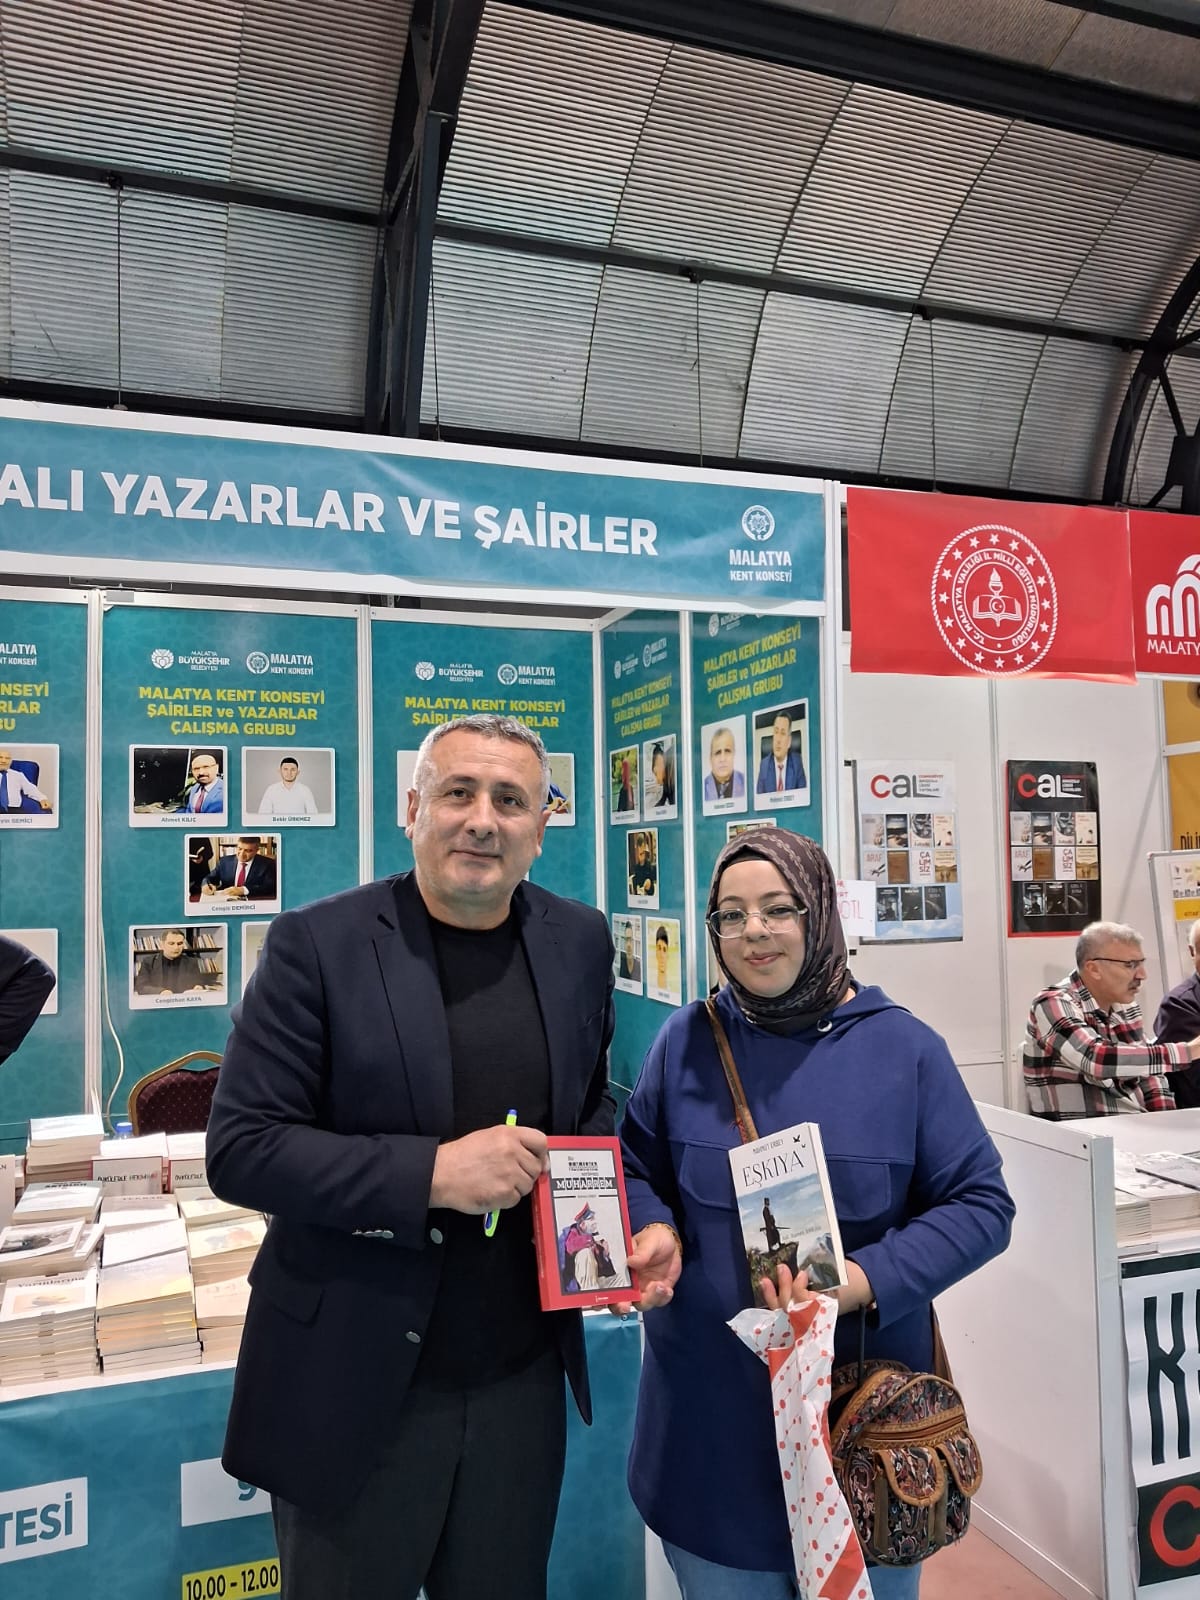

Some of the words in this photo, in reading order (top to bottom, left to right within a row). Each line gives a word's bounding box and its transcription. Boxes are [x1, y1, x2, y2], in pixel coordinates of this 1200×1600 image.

[0, 463, 84, 512] ALI
[101, 471, 386, 533] YAZARLAR
[397, 496, 462, 540] VE
[473, 501, 659, 556] ŞAİRLER
[729, 549, 792, 567] MALATYA
[730, 570, 754, 582] KENT
[755, 569, 793, 583] KONSEYİ
[955, 587, 973, 633] MALATYA
[704, 647, 738, 674] MALATYA
[738, 639, 761, 662] KENT
[761, 622, 802, 652] KONSEYİ
[270, 653, 314, 666] MALATYA
[749, 649, 797, 678] YAZARLAR
[270, 667, 287, 675] KENT
[518, 665, 555, 677] MALATYA
[139, 686, 213, 701] MALATYA
[216, 689, 257, 702] KENT
[260, 690, 325, 705] KONSEYİ
[753, 675, 783, 697] GRUBU
[147, 702, 213, 719] ŞAİRLER
[216, 706, 235, 718] ve
[238, 706, 318, 721] YAZARLAR
[405, 696, 469, 711] MALATYA
[472, 698, 507, 711] KENT
[509, 699, 565, 713] KONSEYİ
[170, 721, 240, 736] ÇALIŞMA
[243, 722, 296, 736] GRUBU
[742, 1150, 805, 1188] EŞKIYA
[1144, 1288, 1200, 1467] K
[241, 1565, 279, 1593] 12.00
